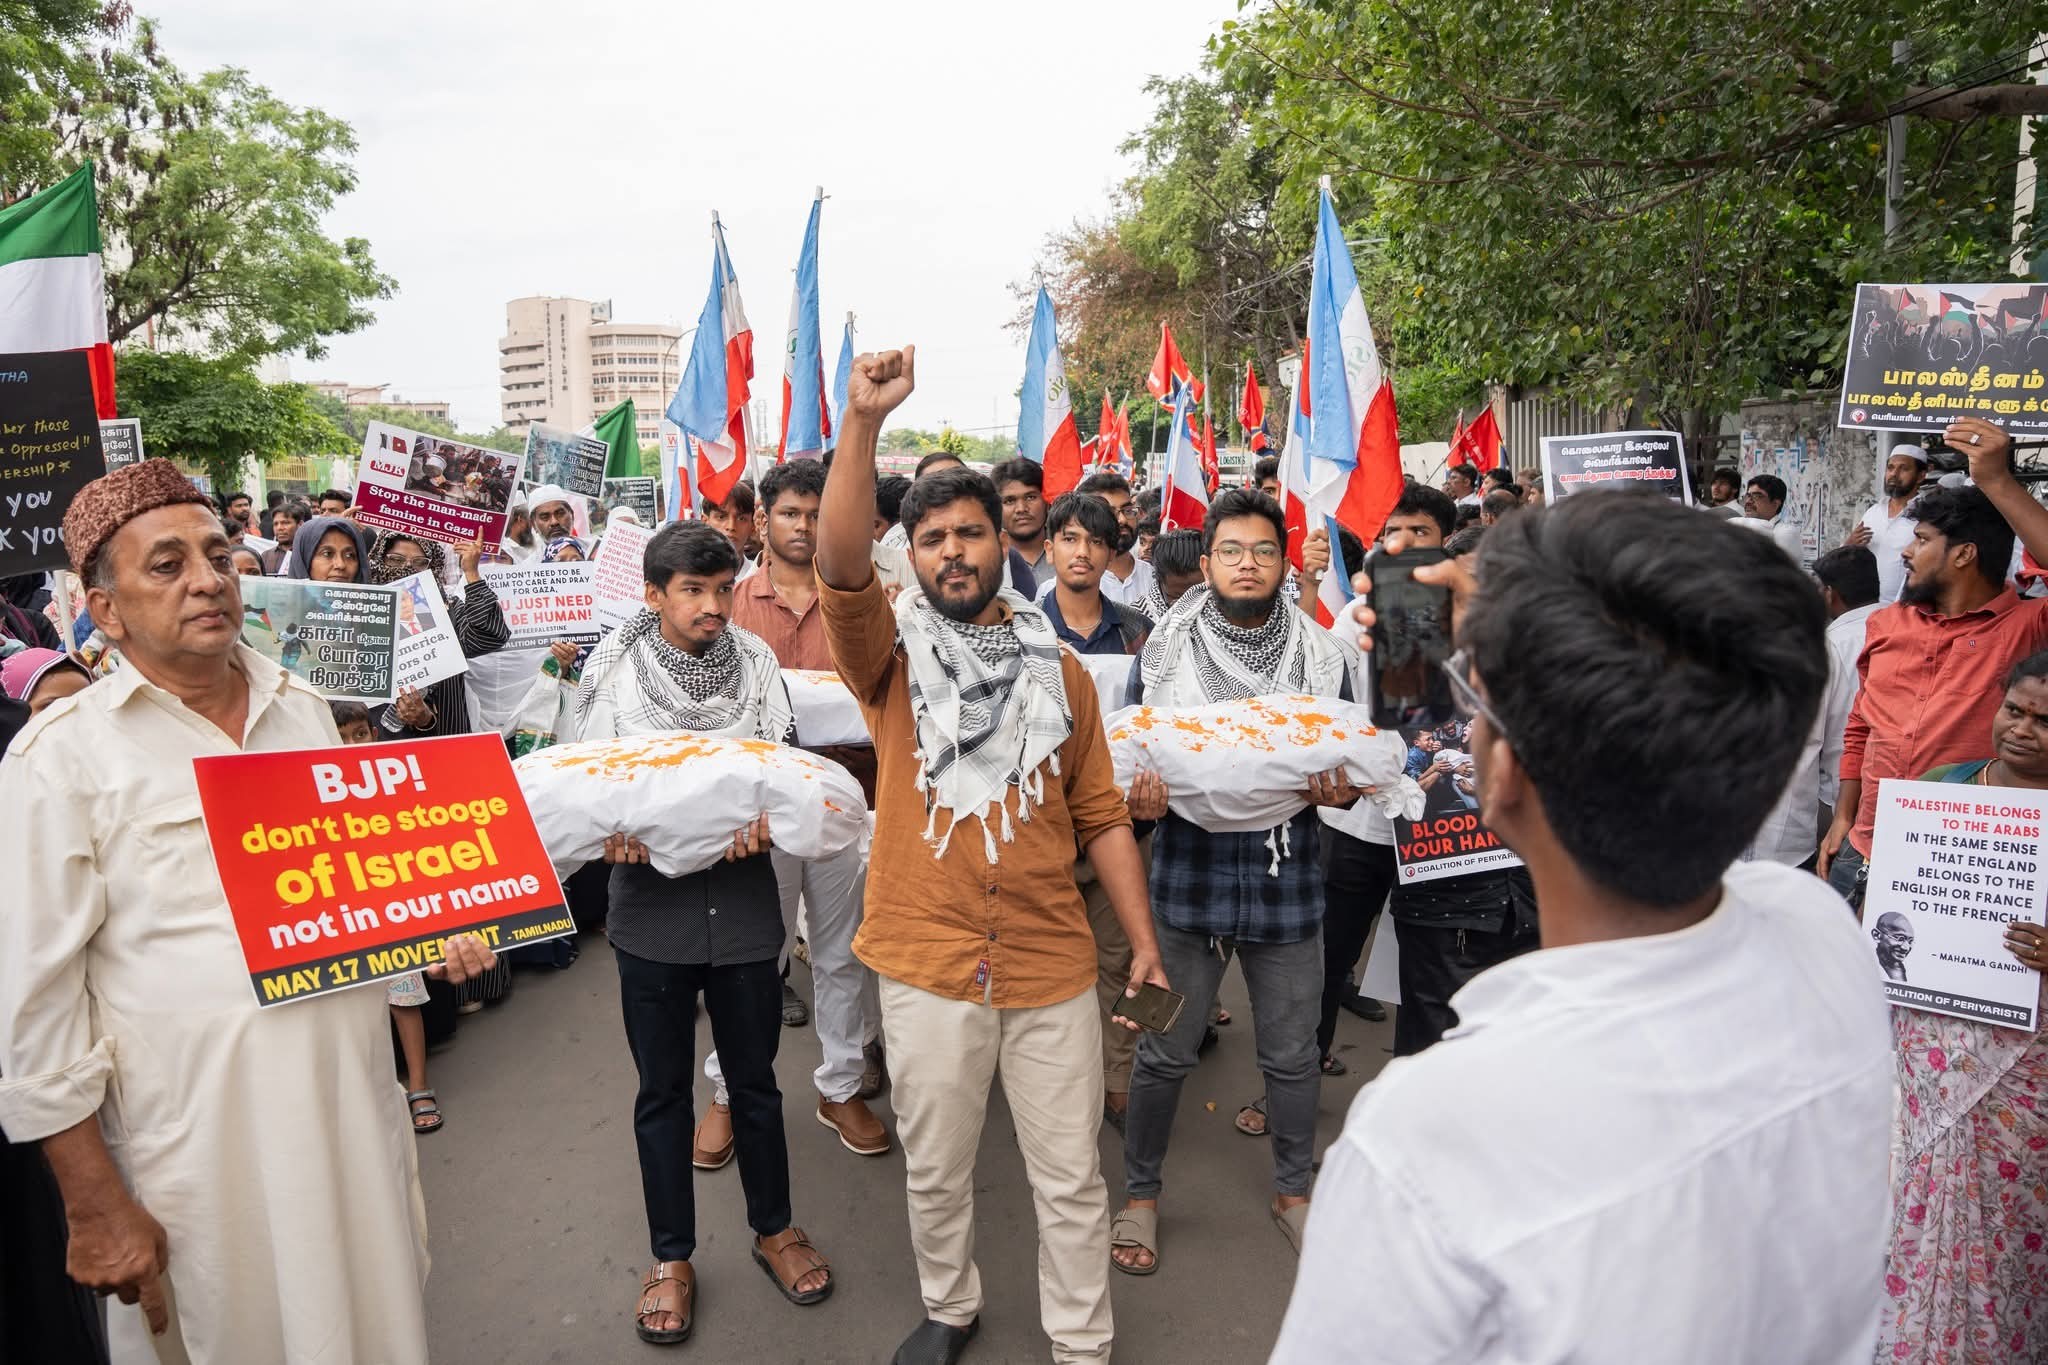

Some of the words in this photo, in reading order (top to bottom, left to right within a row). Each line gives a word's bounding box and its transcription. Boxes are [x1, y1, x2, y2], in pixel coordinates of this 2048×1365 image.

[1883, 365, 2045, 392] பாலஸ்தீனம்
[35, 420, 70, 434] those
[373, 460, 404, 477] MJK
[369, 485, 400, 503] Stop
[404, 495, 425, 508] the
[427, 501, 494, 523] man-made
[355, 513, 406, 532] Humanity
[379, 504, 425, 524] famine
[427, 517, 441, 528] in
[444, 522, 475, 537] Gaza
[485, 573, 503, 581] YOU
[506, 571, 531, 579] DON'T
[534, 569, 556, 578] NEED
[571, 568, 580, 576] BE
[512, 579, 523, 587] TO
[526, 578, 547, 586] CARE
[569, 576, 590, 584] PRAY
[325, 589, 391, 604] கொலைகார
[532, 586, 558, 594] GAZA,
[330, 600, 391, 614] இஸ்ரேலே!
[516, 597, 550, 610] JUST
[556, 595, 593, 607] NEED
[305, 611, 390, 625] அமெரிக்காவே!
[511, 614, 528, 625] BE
[534, 609, 592, 625] HUMAN!
[298, 625, 354, 643] காசா
[398, 633, 449, 656] merica,
[318, 645, 388, 669] போரை
[423, 648, 437, 661] of
[396, 667, 429, 688] srael
[311, 754, 427, 804] BJP!
[1895, 798, 1971, 814] "PALESTINE
[1975, 804, 2041, 820] BELONGS
[241, 816, 342, 854] don't
[344, 811, 391, 840] be
[399, 796, 509, 832] stooge
[1412, 814, 1478, 839] BLOOD
[1942, 818, 1959, 830] TO
[1964, 820, 1989, 833] THE
[1993, 824, 2040, 838] ARABS
[1400, 838, 1455, 860] YOUR
[1905, 831, 1919, 843] IN
[1924, 833, 1947, 846] THE
[1951, 837, 1988, 850] SAME
[1992, 841, 2038, 856] SENSE
[275, 852, 336, 905] of
[344, 828, 499, 892] Israel
[1417, 861, 1462, 873] COALITION
[1931, 851, 1964, 865] THAT
[1968, 855, 2037, 873] ENGLAND
[1918, 867, 1980, 883] BELONGS
[1985, 875, 2003, 887] TO
[2008, 878, 2035, 891] THE
[1892, 880, 1947, 897] ENGLISH
[1951, 889, 1970, 900] OR
[1975, 892, 2033, 909] FRANCE
[268, 910, 339, 950] not
[340, 903, 379, 934] in
[385, 893, 444, 924] our
[448, 874, 540, 910] name
[1912, 900, 1928, 911] TO
[1934, 903, 1957, 916] THE
[261, 966, 323, 1001] MAY
[327, 959, 359, 987] 17
[512, 918, 572, 941] TAMILNADU
[1939, 953, 1986, 967] MAHATMA
[1989, 961, 2028, 974] GANDHI
[1884, 986, 1933, 1002] OALITION
[1935, 996, 1951, 1005] OF
[1952, 999, 2028, 1021] PERIYARISTS
